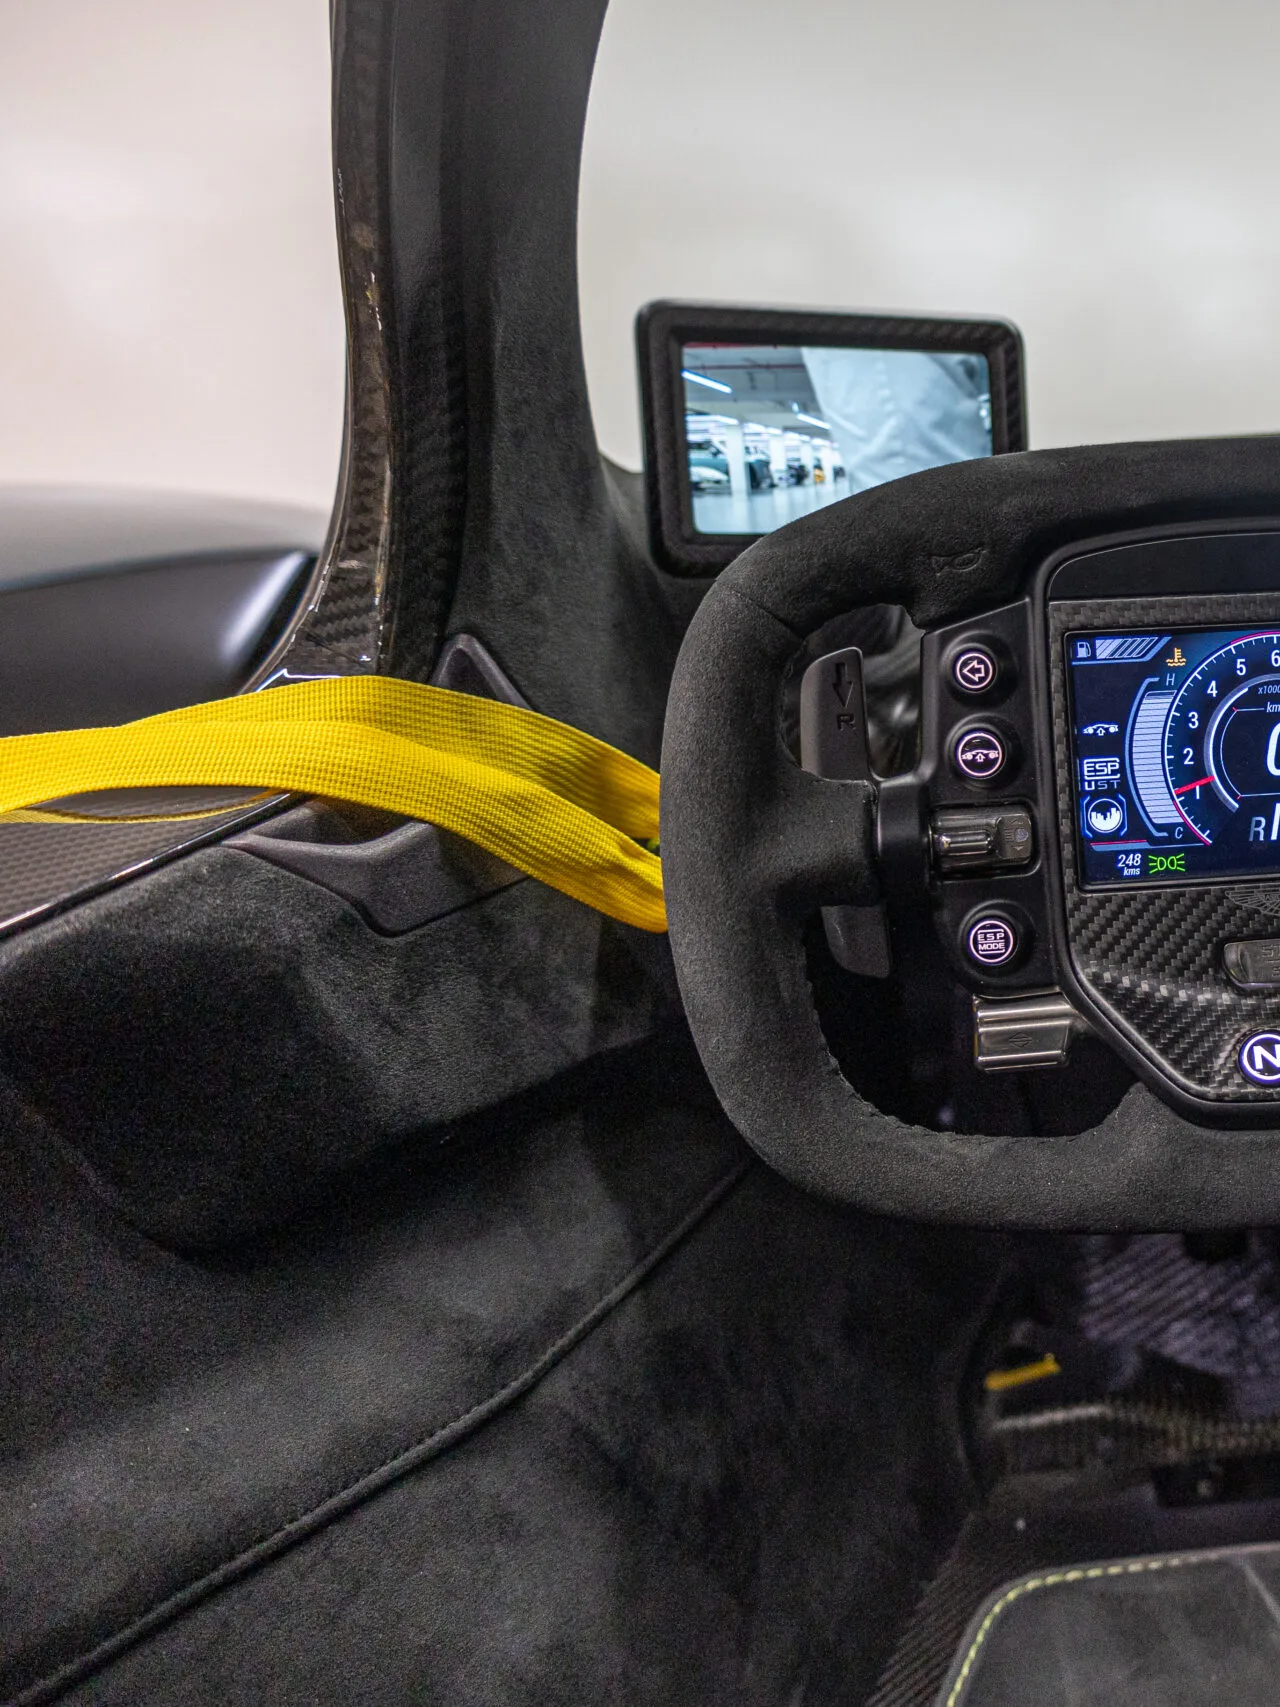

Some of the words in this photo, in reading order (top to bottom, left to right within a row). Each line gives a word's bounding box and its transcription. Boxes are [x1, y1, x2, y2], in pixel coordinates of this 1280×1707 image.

[1236, 658, 1247, 676] 5
[1166, 673, 1176, 686] H
[1206, 680, 1218, 698] 4
[837, 714, 855, 731] R
[1188, 711, 1199, 729] 3
[1183, 747, 1195, 765] 2
[1084, 762, 1119, 776] ESP
[1193, 784, 1200, 800] 1
[1174, 826, 1183, 839] C
[1249, 816, 1266, 841] R
[1118, 853, 1141, 867] 248
[1123, 867, 1140, 876] kms
[978, 933, 1005, 941] ESP
[978, 942, 1005, 951] MODE
